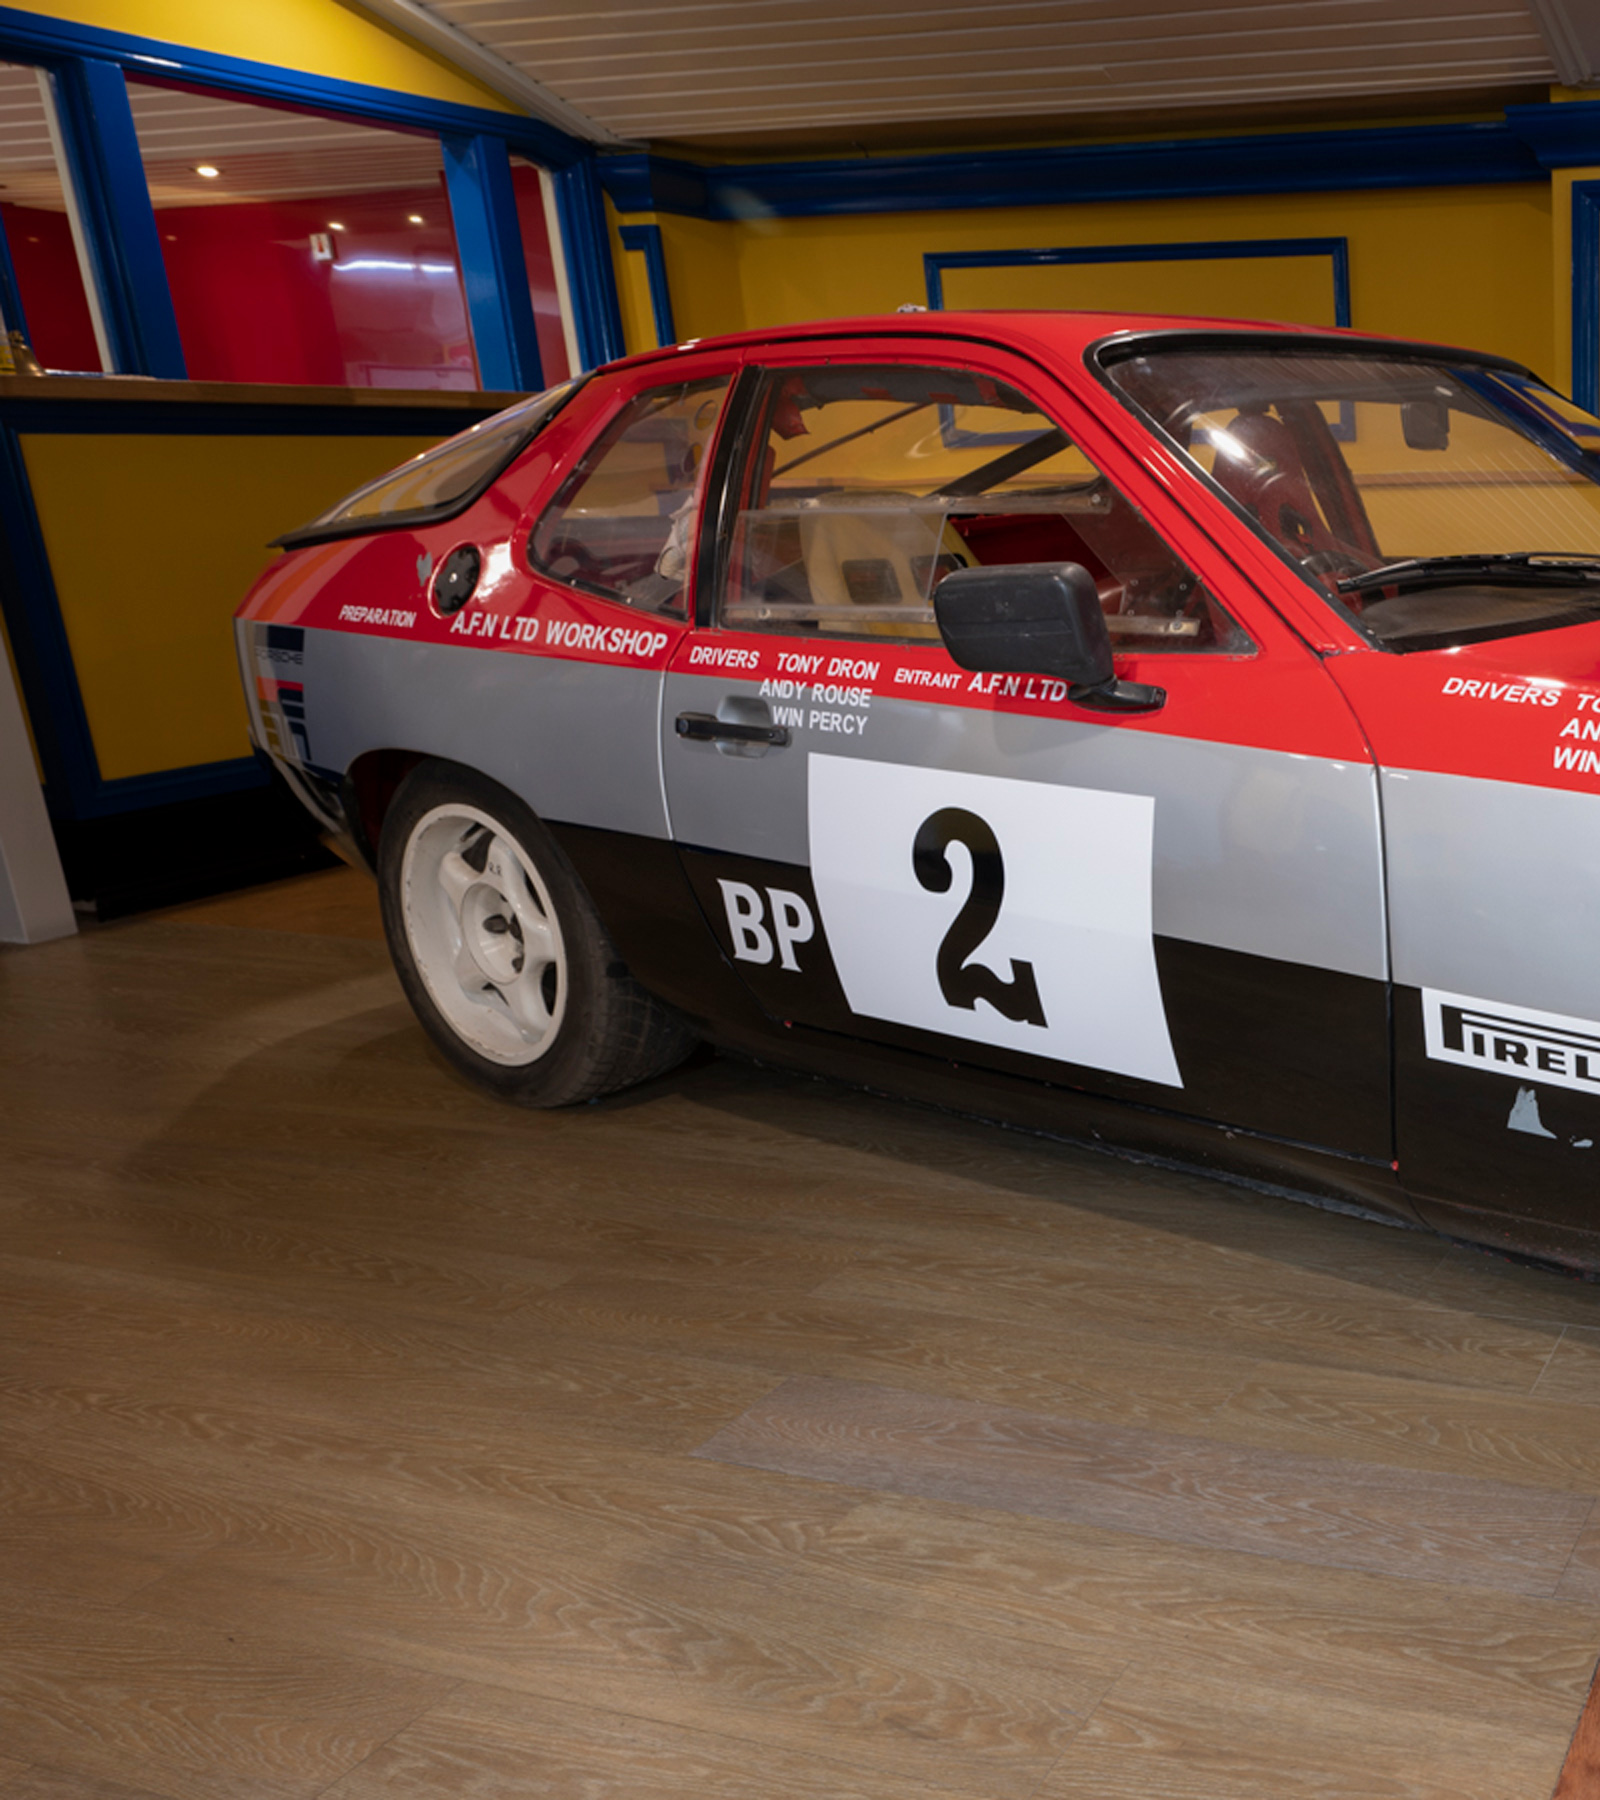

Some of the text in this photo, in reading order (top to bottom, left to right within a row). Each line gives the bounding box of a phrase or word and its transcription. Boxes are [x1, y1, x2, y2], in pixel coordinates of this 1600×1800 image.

[338, 605, 417, 628] PREPARATION
[450, 611, 668, 657] A.F.N LTD WORKSHOP
[689, 646, 880, 680] DRIVERS TONY DRON
[759, 678, 872, 708] ANDY ROUSE
[894, 667, 1068, 702] ENTRANT A.F.N LTD
[1442, 677, 1561, 707] DRIVERS
[772, 705, 868, 735] WIN PERCY
[715, 877, 815, 974] BP
[912, 806, 1049, 1029] 2
